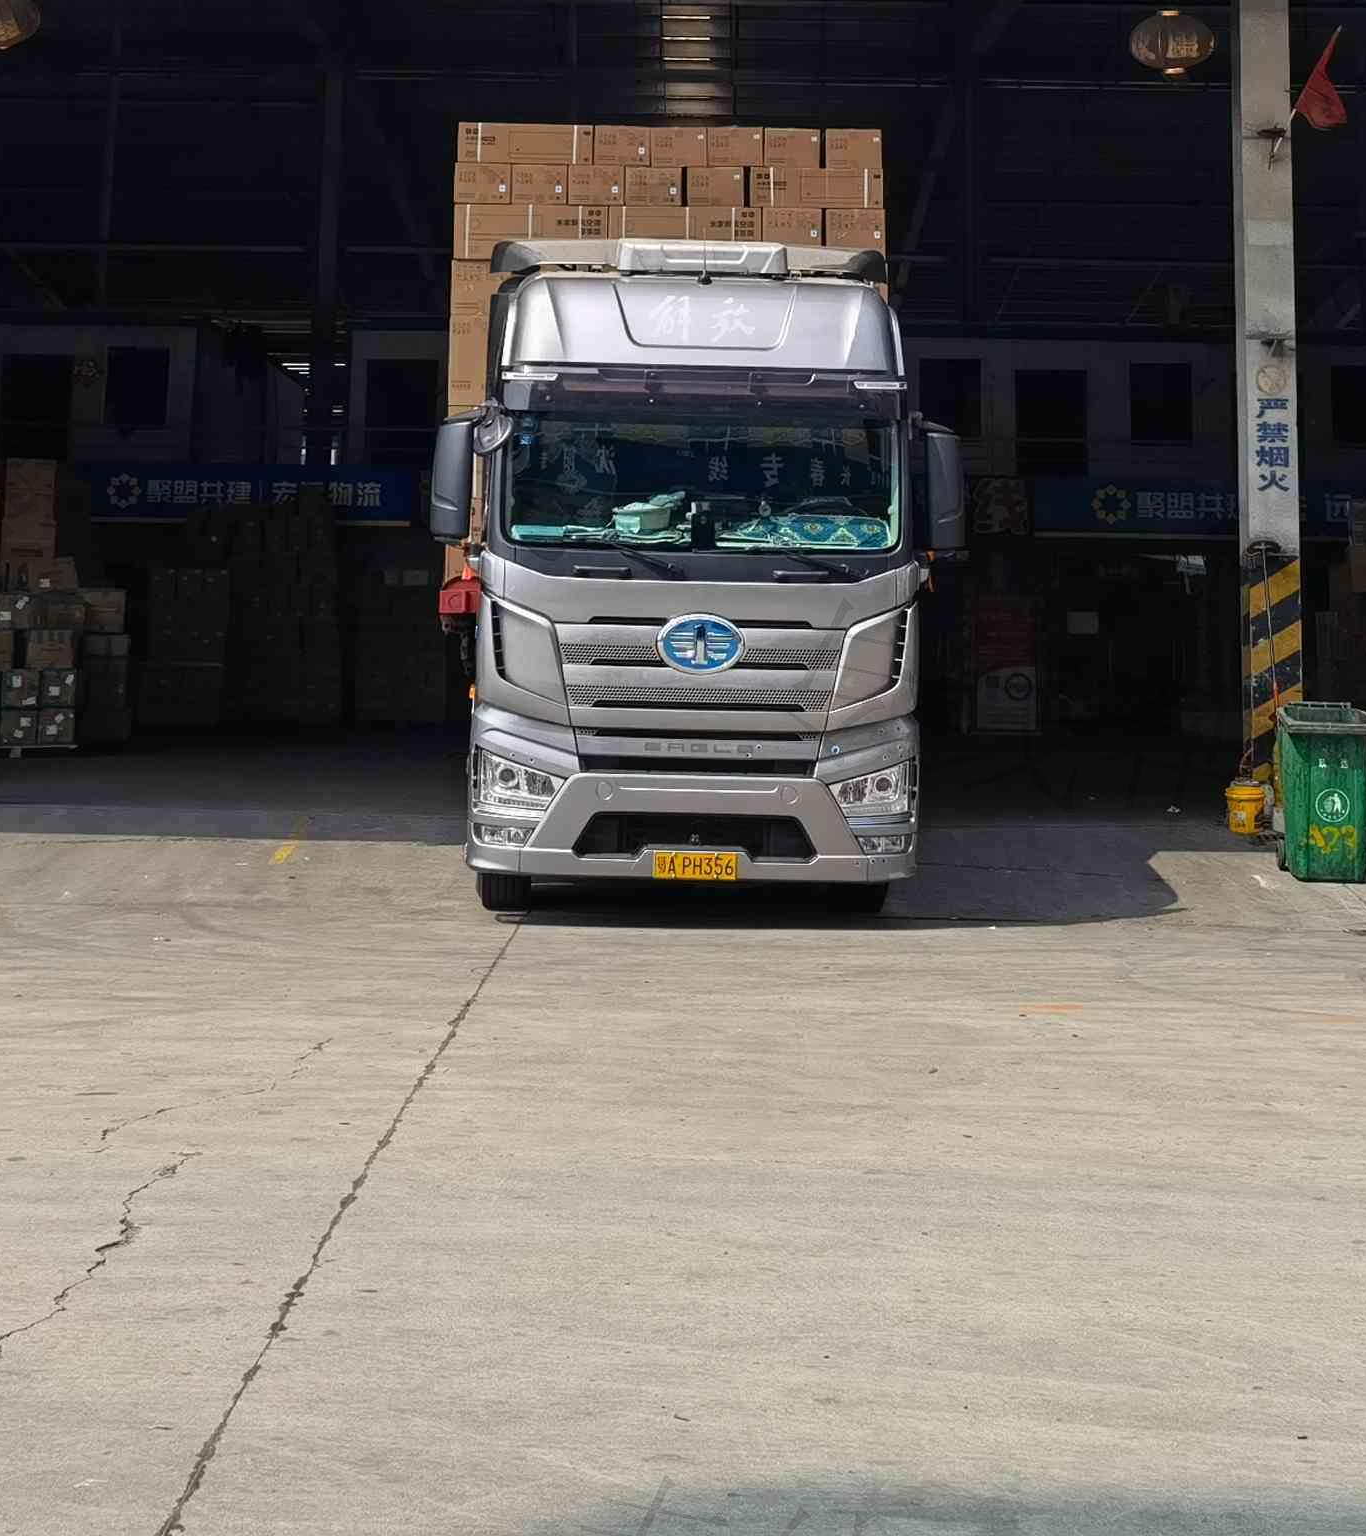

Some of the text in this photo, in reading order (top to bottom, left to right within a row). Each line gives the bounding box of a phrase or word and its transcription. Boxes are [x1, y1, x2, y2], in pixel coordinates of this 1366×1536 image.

[1255, 398, 1290, 493] 严禁烟火
[271, 480, 382, 508] 宏物流
